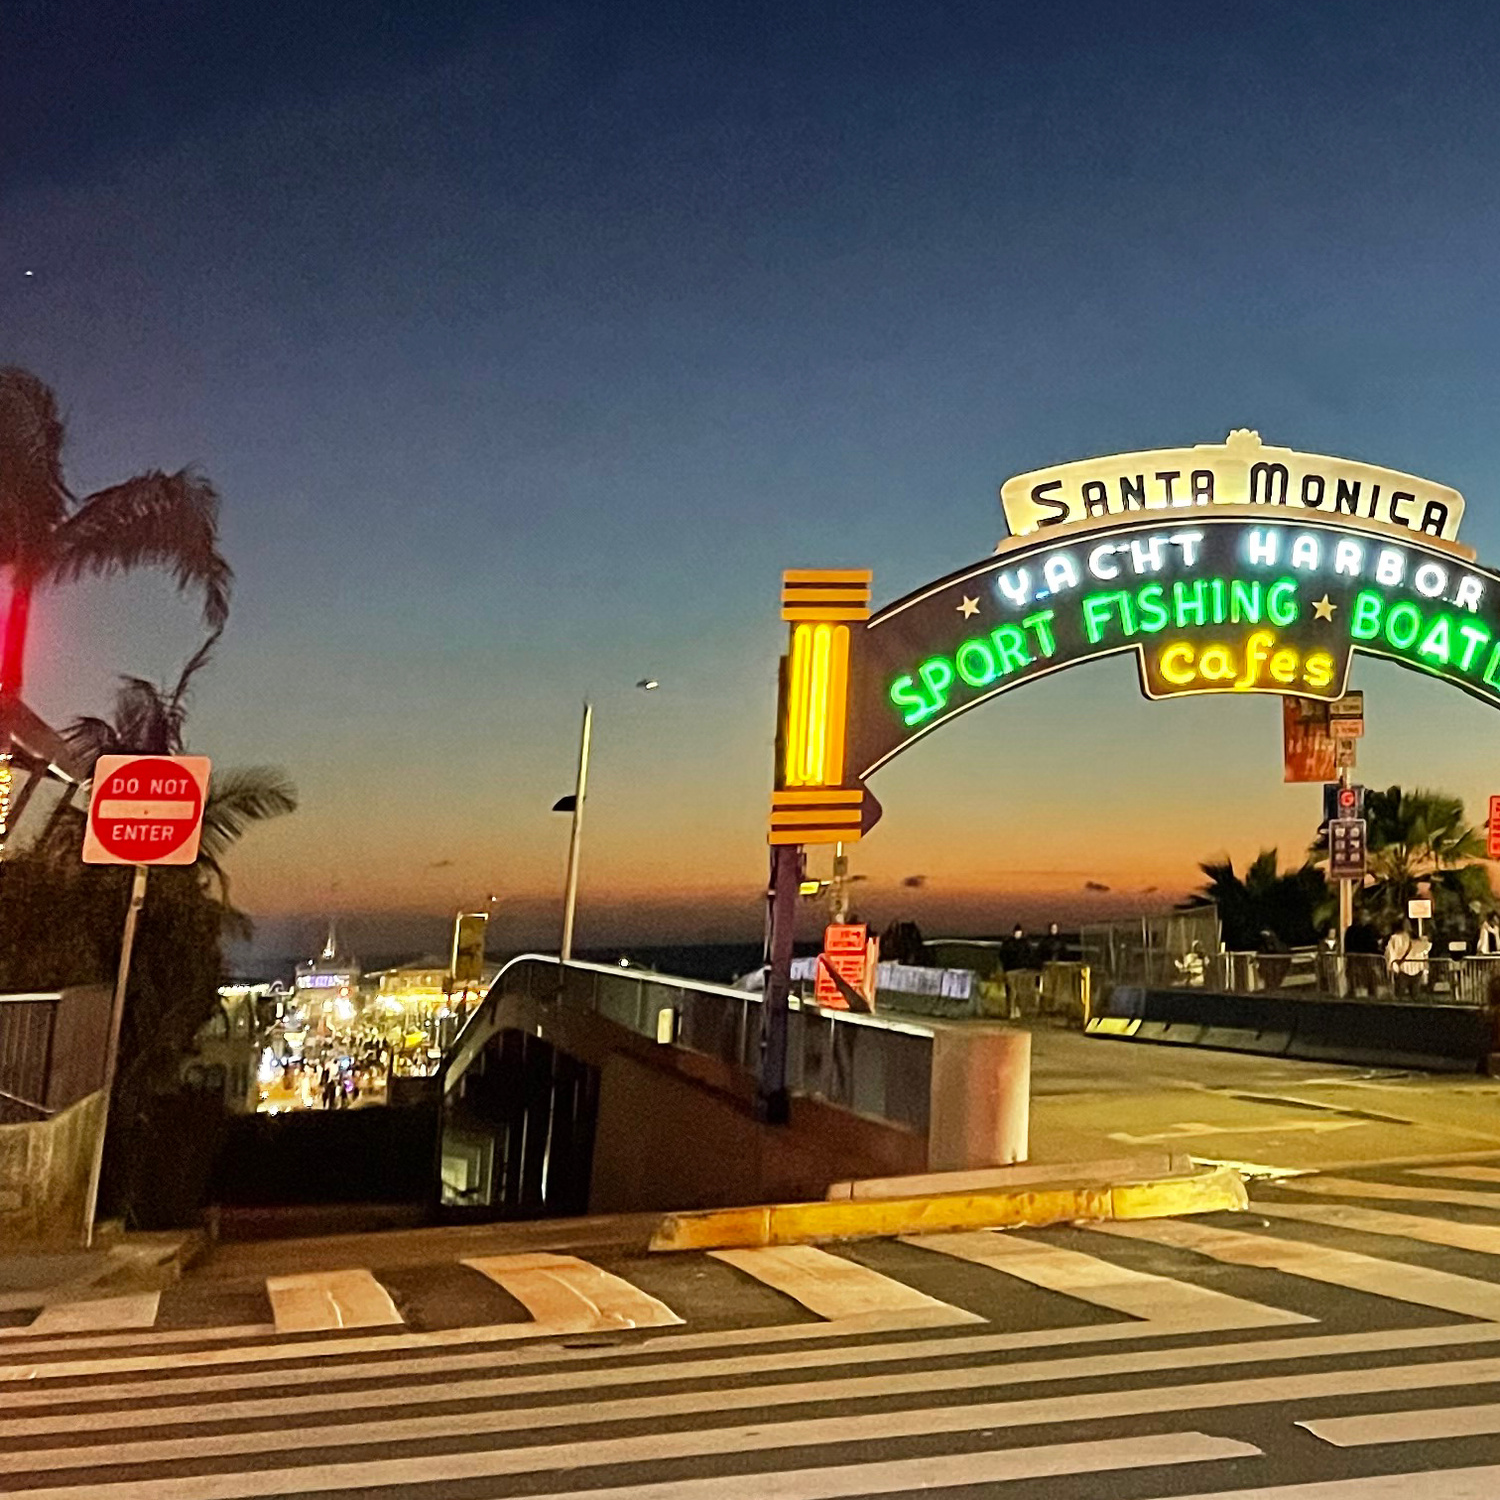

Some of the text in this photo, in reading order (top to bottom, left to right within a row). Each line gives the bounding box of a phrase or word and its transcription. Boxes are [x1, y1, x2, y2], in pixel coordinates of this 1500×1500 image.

[1031, 462, 1448, 538] SANTA MONICA
[999, 531, 1485, 612] YACHT HARBOR
[890, 610, 1056, 726] SPORT
[1082, 578, 1298, 644] FISHING
[1159, 632, 1333, 688] cafes
[112, 778, 189, 795] DO NOT
[112, 825, 174, 841] ENTER
